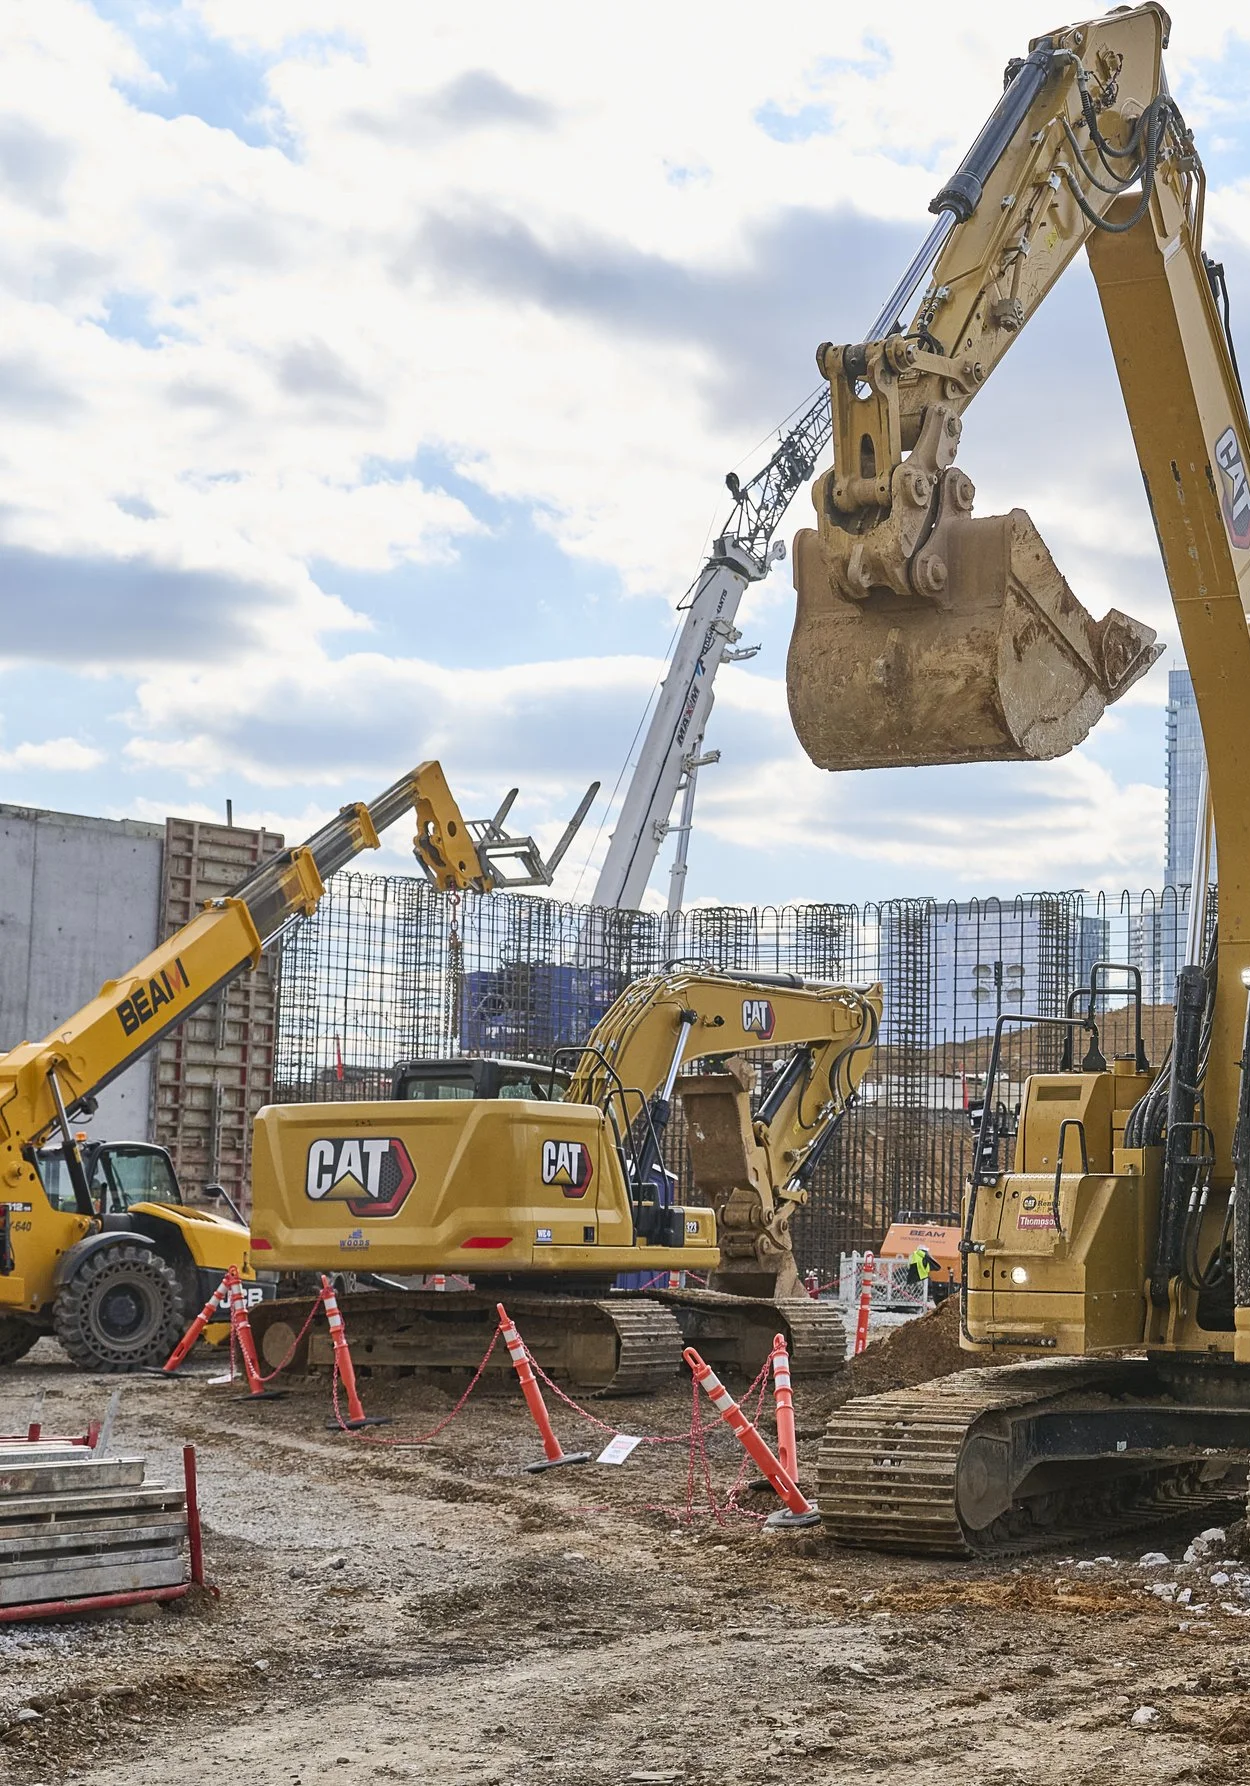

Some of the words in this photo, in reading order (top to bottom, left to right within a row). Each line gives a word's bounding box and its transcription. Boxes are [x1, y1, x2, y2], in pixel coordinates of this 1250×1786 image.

[115, 957, 190, 1037] BEAM
[742, 1000, 768, 1031] CAT
[307, 1139, 390, 1199] CAT
[543, 1140, 581, 1184] CAT
[686, 1221, 697, 1233] 323
[909, 1229, 946, 1238] BEAM
